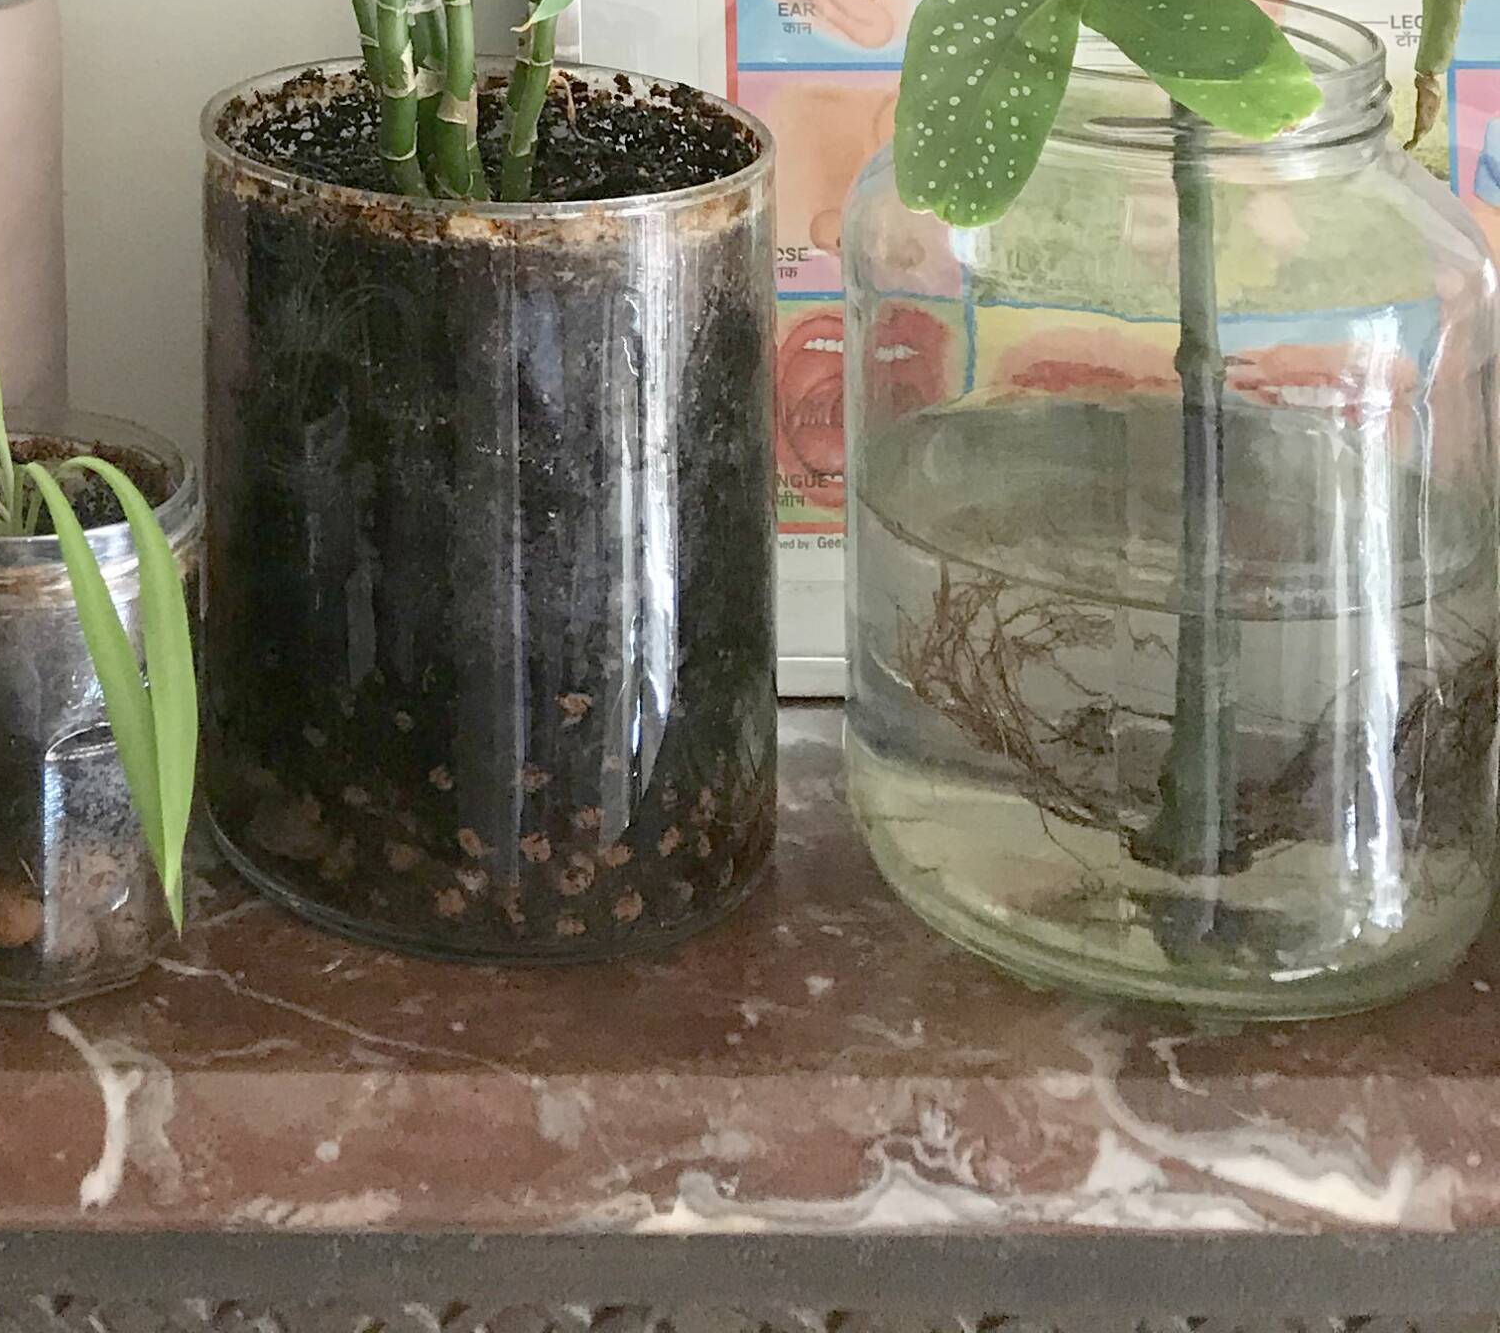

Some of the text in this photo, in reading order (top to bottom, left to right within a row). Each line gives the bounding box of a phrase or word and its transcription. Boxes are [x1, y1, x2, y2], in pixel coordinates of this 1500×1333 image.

[777, 1, 816, 17] EAR
[781, 22, 813, 35] कान
[776, 473, 829, 488] NGUE
